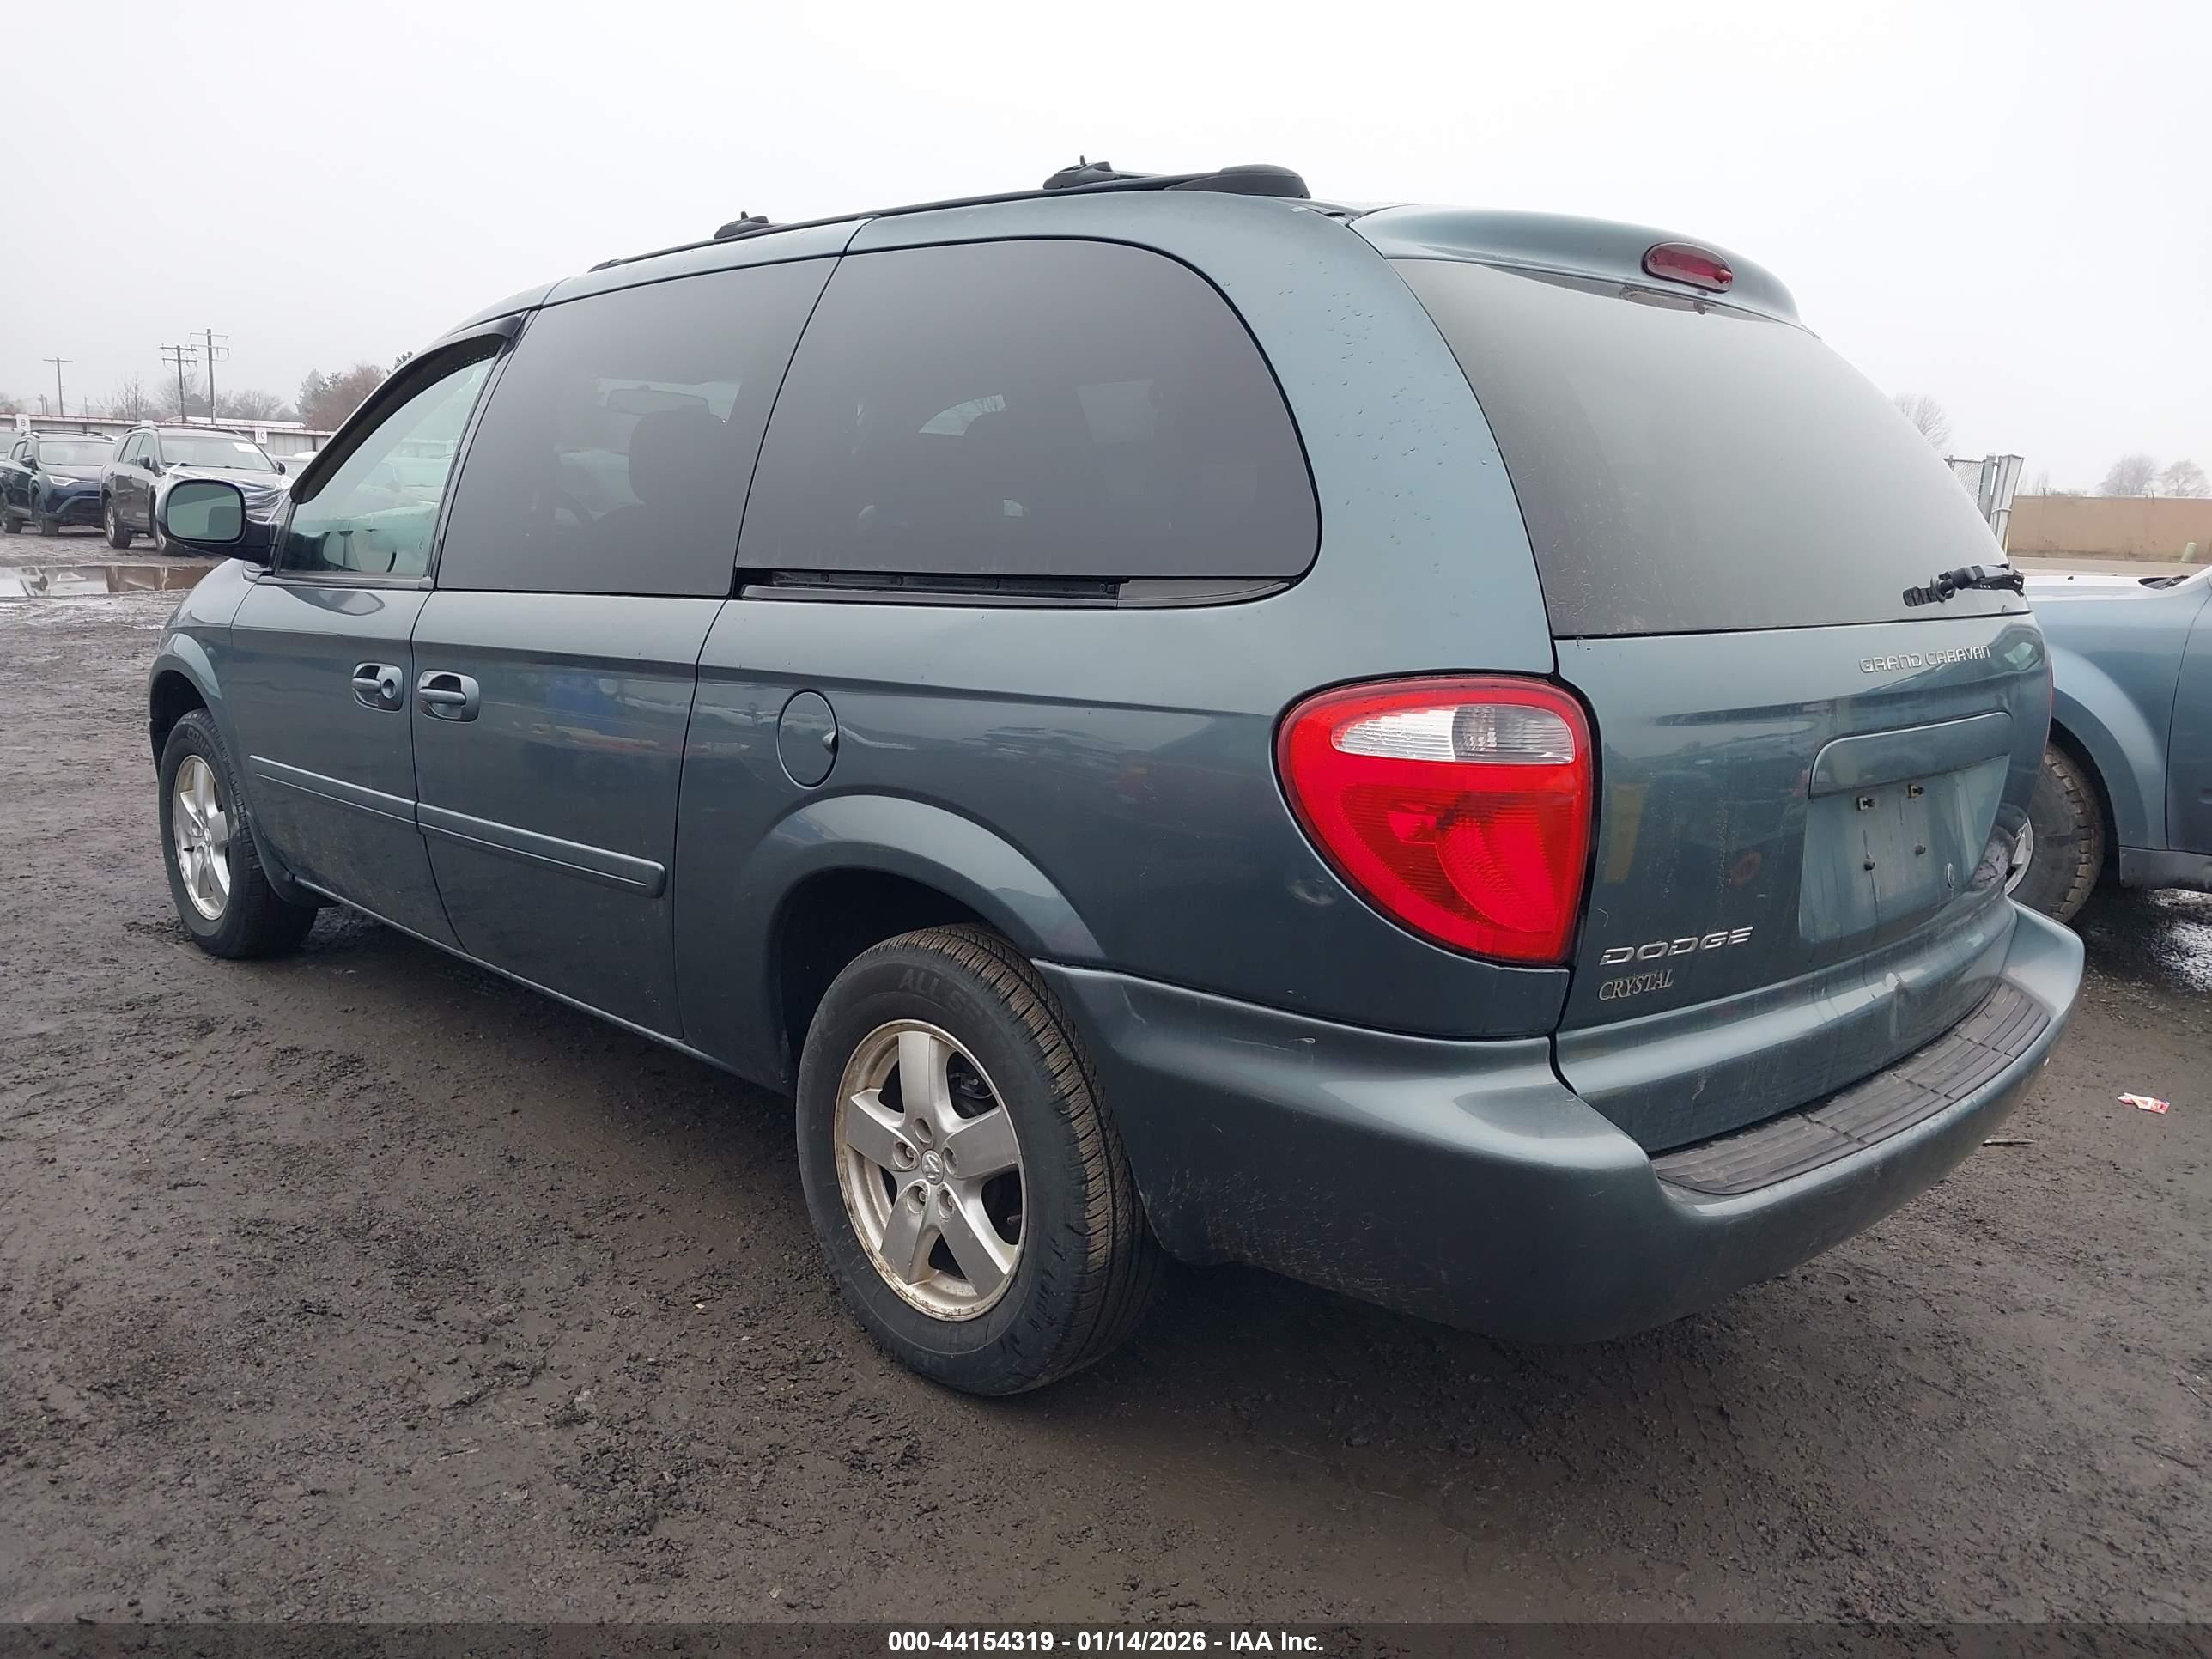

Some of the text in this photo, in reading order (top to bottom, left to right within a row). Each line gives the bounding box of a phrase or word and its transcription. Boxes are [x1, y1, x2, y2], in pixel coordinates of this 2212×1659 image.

[258, 431, 265, 440] 10
[1859, 645, 1991, 673] GRAND CARAVAN
[1599, 927, 1753, 966] DODGE
[1598, 969, 1674, 1000] CRYSTAL
